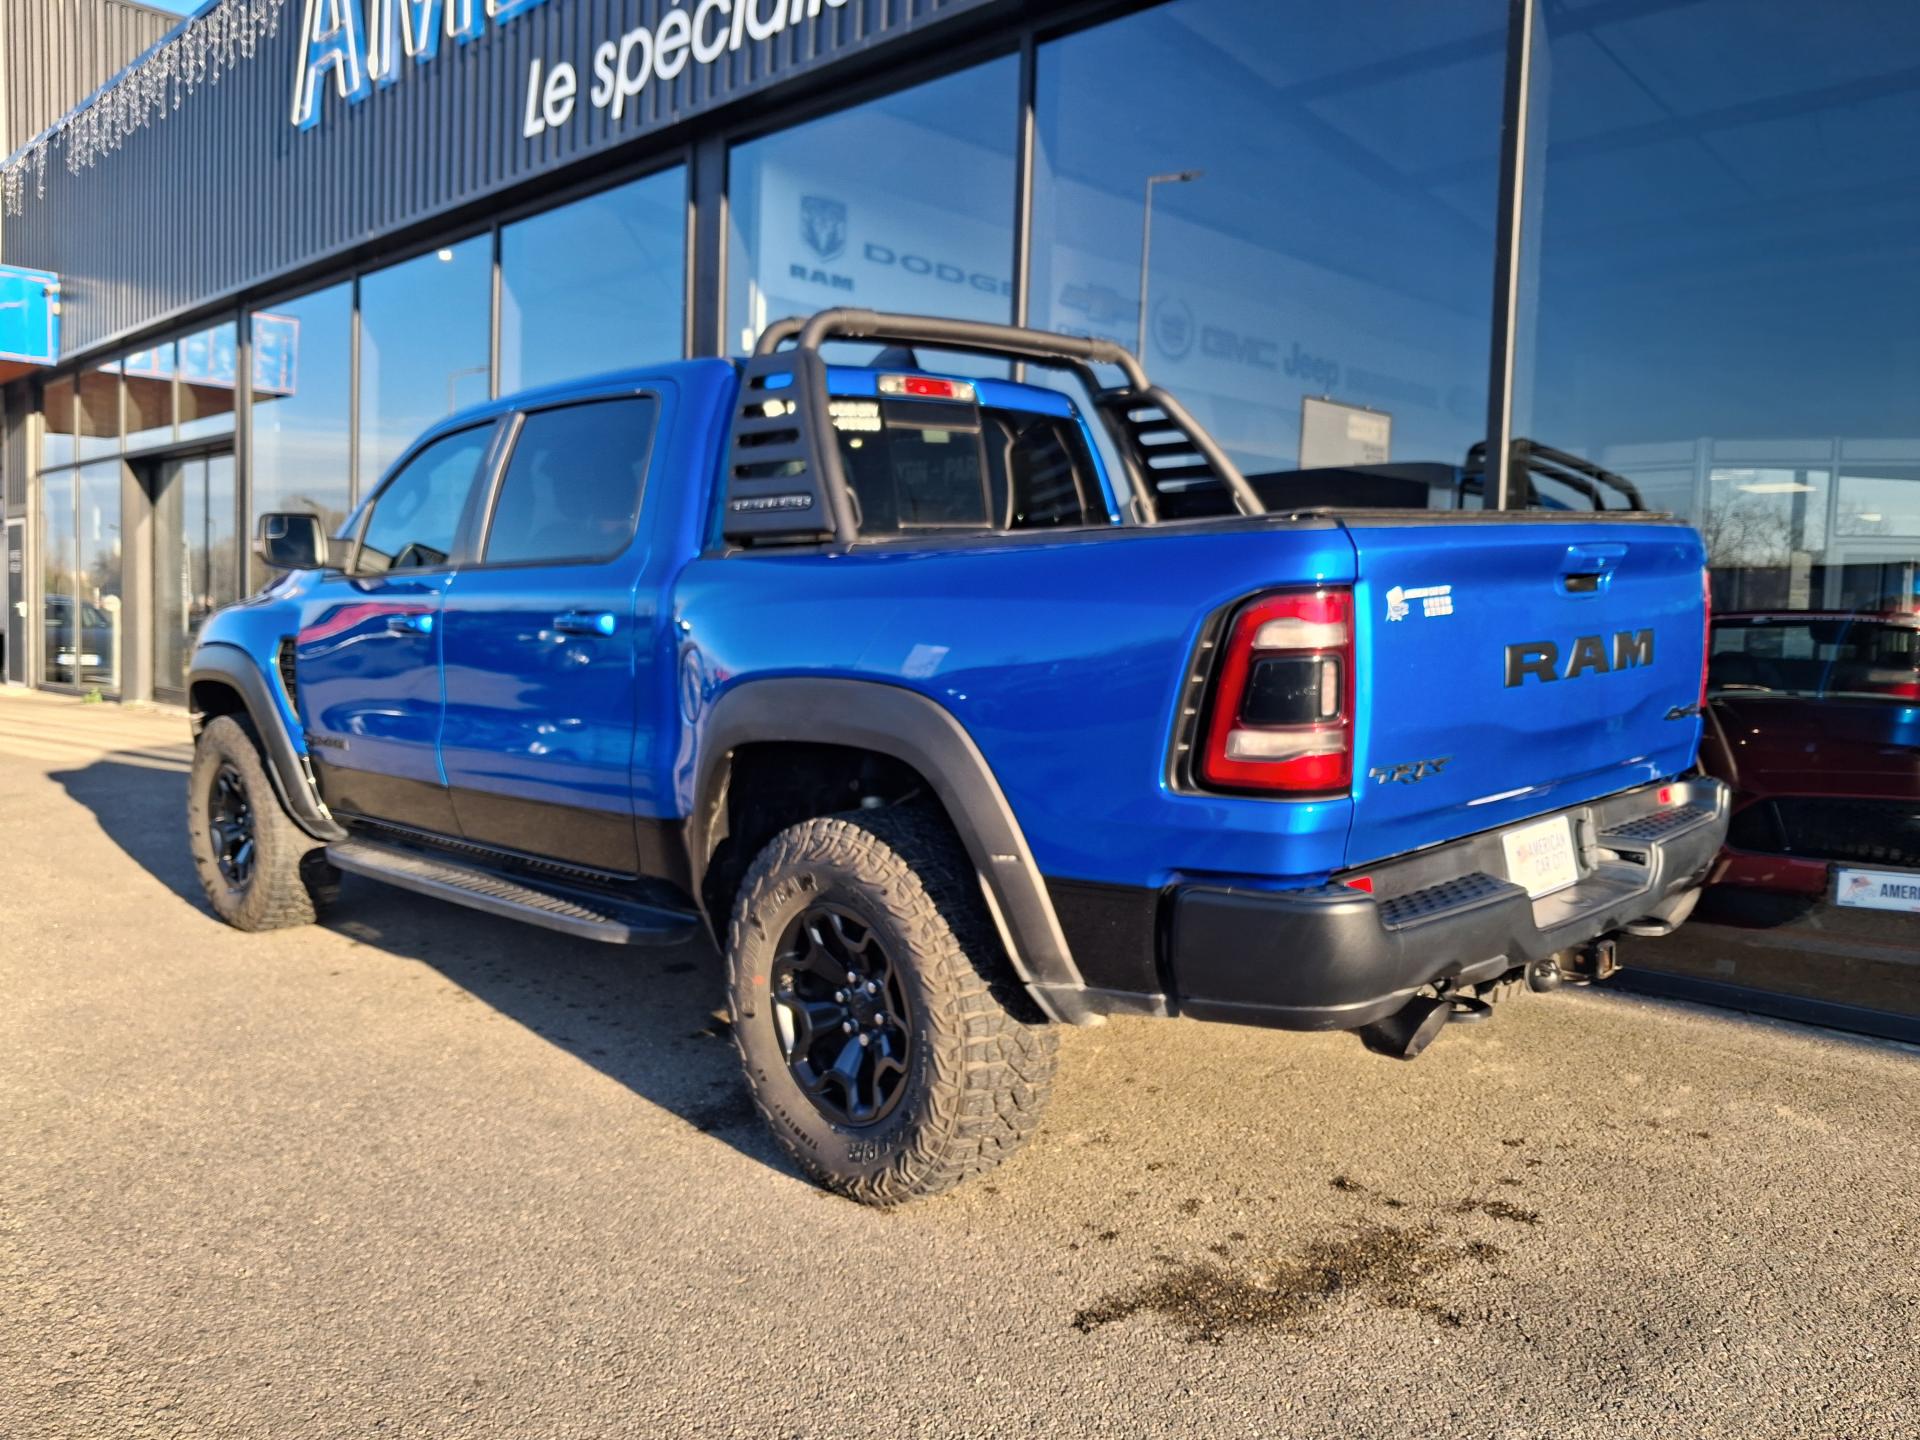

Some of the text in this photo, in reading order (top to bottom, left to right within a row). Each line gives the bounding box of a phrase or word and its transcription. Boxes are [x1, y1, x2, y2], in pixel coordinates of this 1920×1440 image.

[523, 0, 848, 137] Le spécia
[789, 263, 854, 292] RAM
[1504, 628, 1654, 688] RAM
